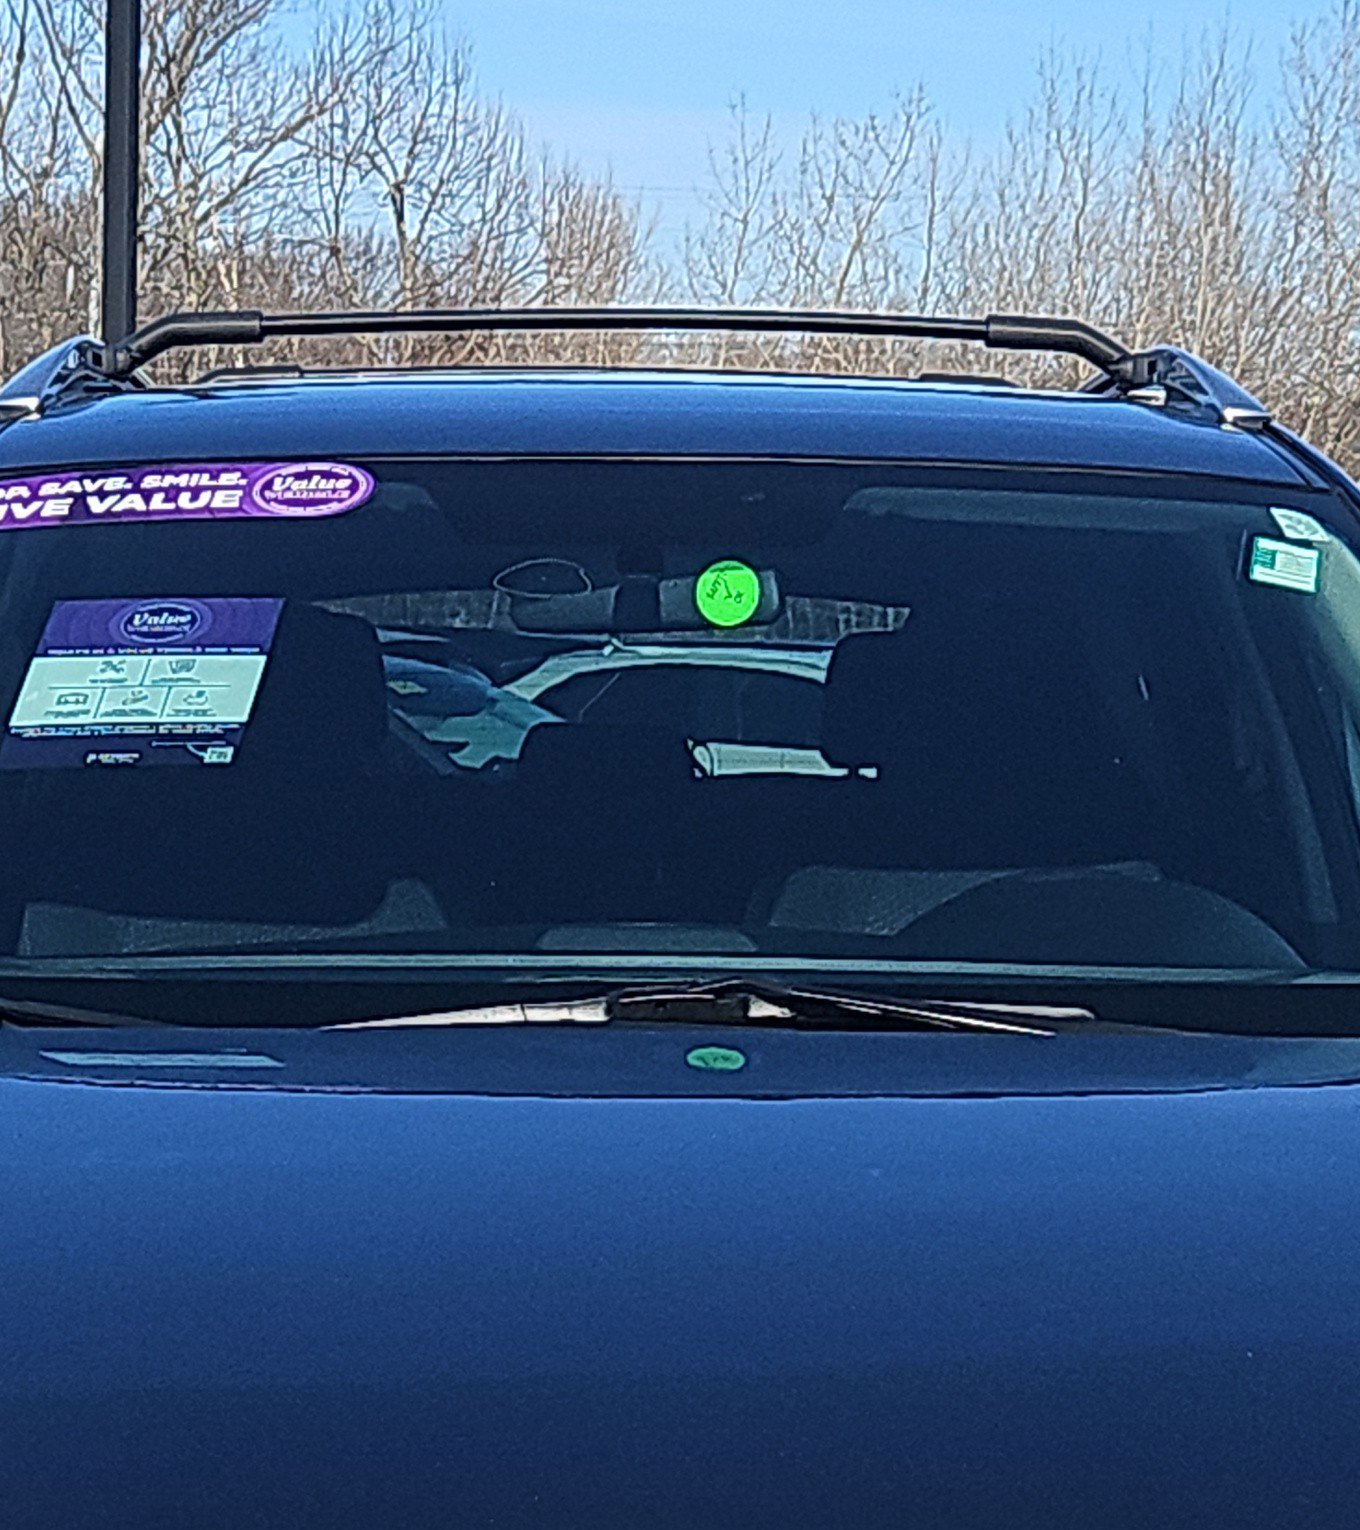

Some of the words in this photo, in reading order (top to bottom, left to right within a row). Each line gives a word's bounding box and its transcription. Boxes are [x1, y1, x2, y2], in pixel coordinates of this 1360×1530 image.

[140, 471, 248, 489] SMILE.
[272, 475, 353, 491] Value
[86, 489, 244, 514] VALUE
